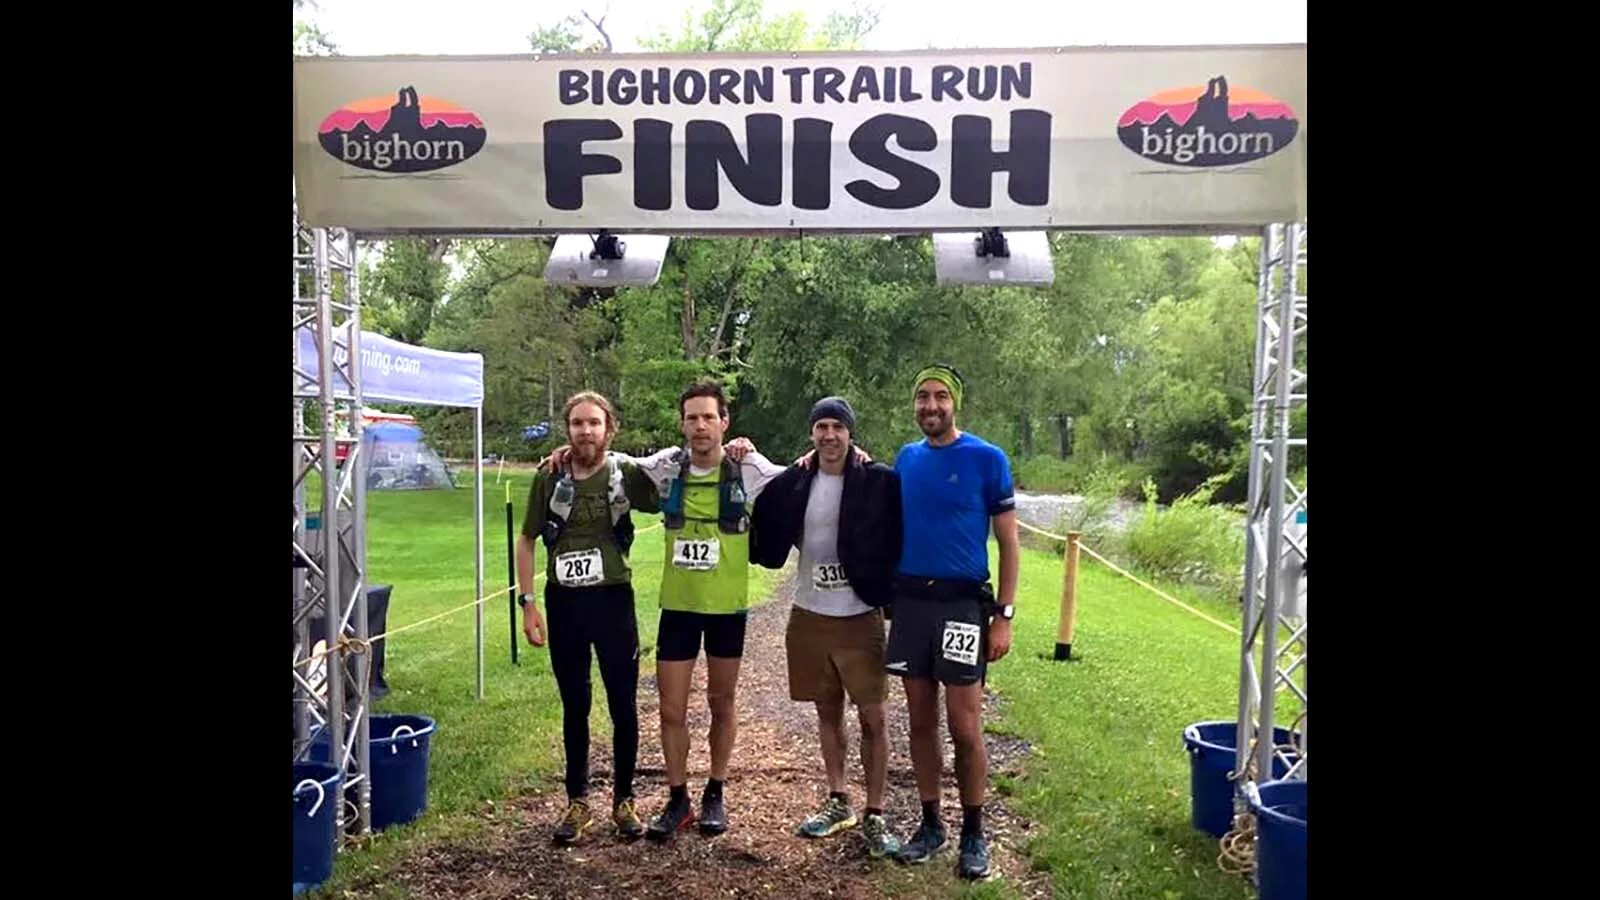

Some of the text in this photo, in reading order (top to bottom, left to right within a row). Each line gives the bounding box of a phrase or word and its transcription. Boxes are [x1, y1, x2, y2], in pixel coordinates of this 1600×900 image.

[559, 63, 1032, 106] BIGHORN TRAIL RUN
[342, 133, 465, 168] bighorn
[1141, 127, 1275, 161] bighorn
[543, 109, 1053, 212] FINISH
[682, 543, 709, 560] 412
[564, 558, 592, 578] 287
[818, 565, 849, 582] 330
[945, 631, 976, 653] 232
